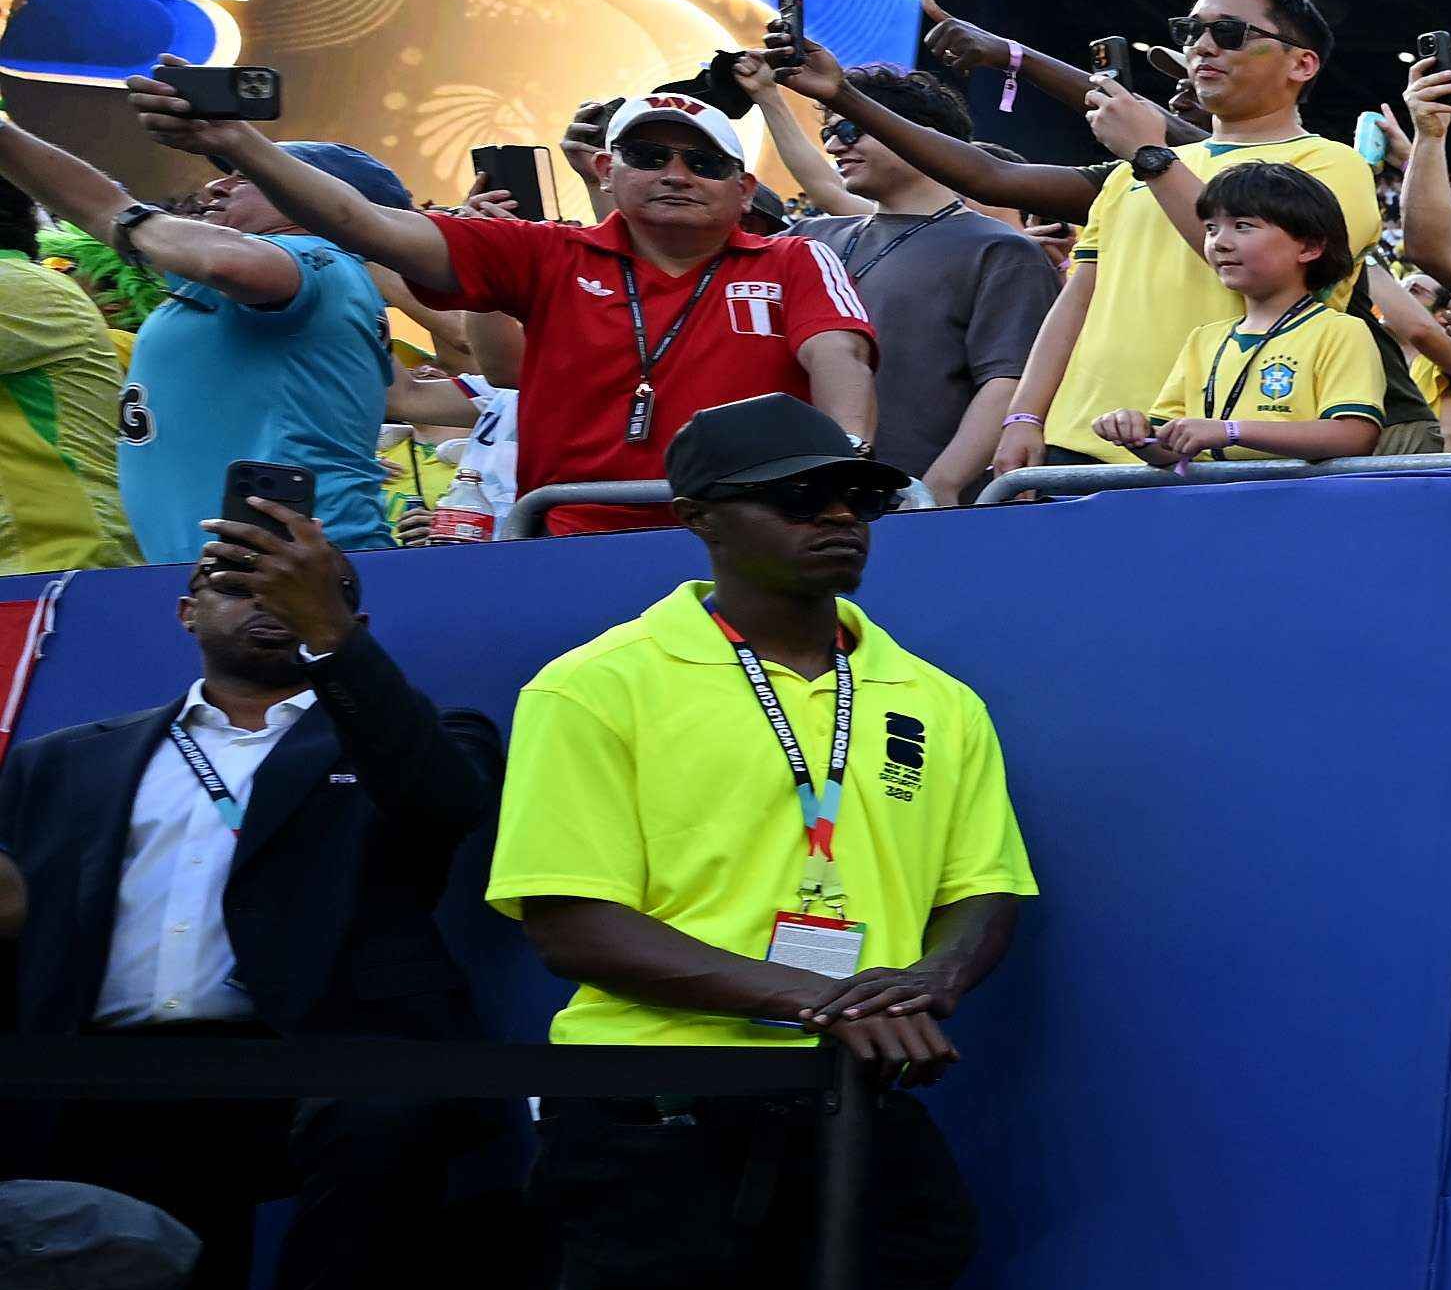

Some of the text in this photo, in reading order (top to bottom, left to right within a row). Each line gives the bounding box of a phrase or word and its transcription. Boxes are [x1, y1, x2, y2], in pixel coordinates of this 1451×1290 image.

[732, 284, 778, 297] FPF
[1257, 404, 1292, 413] BRASIL
[755, 687, 777, 708] CUP
[838, 671, 851, 708] WORLD
[768, 707, 796, 749] WORLD
[836, 708, 849, 730] CUP
[788, 749, 807, 772] FIFA
